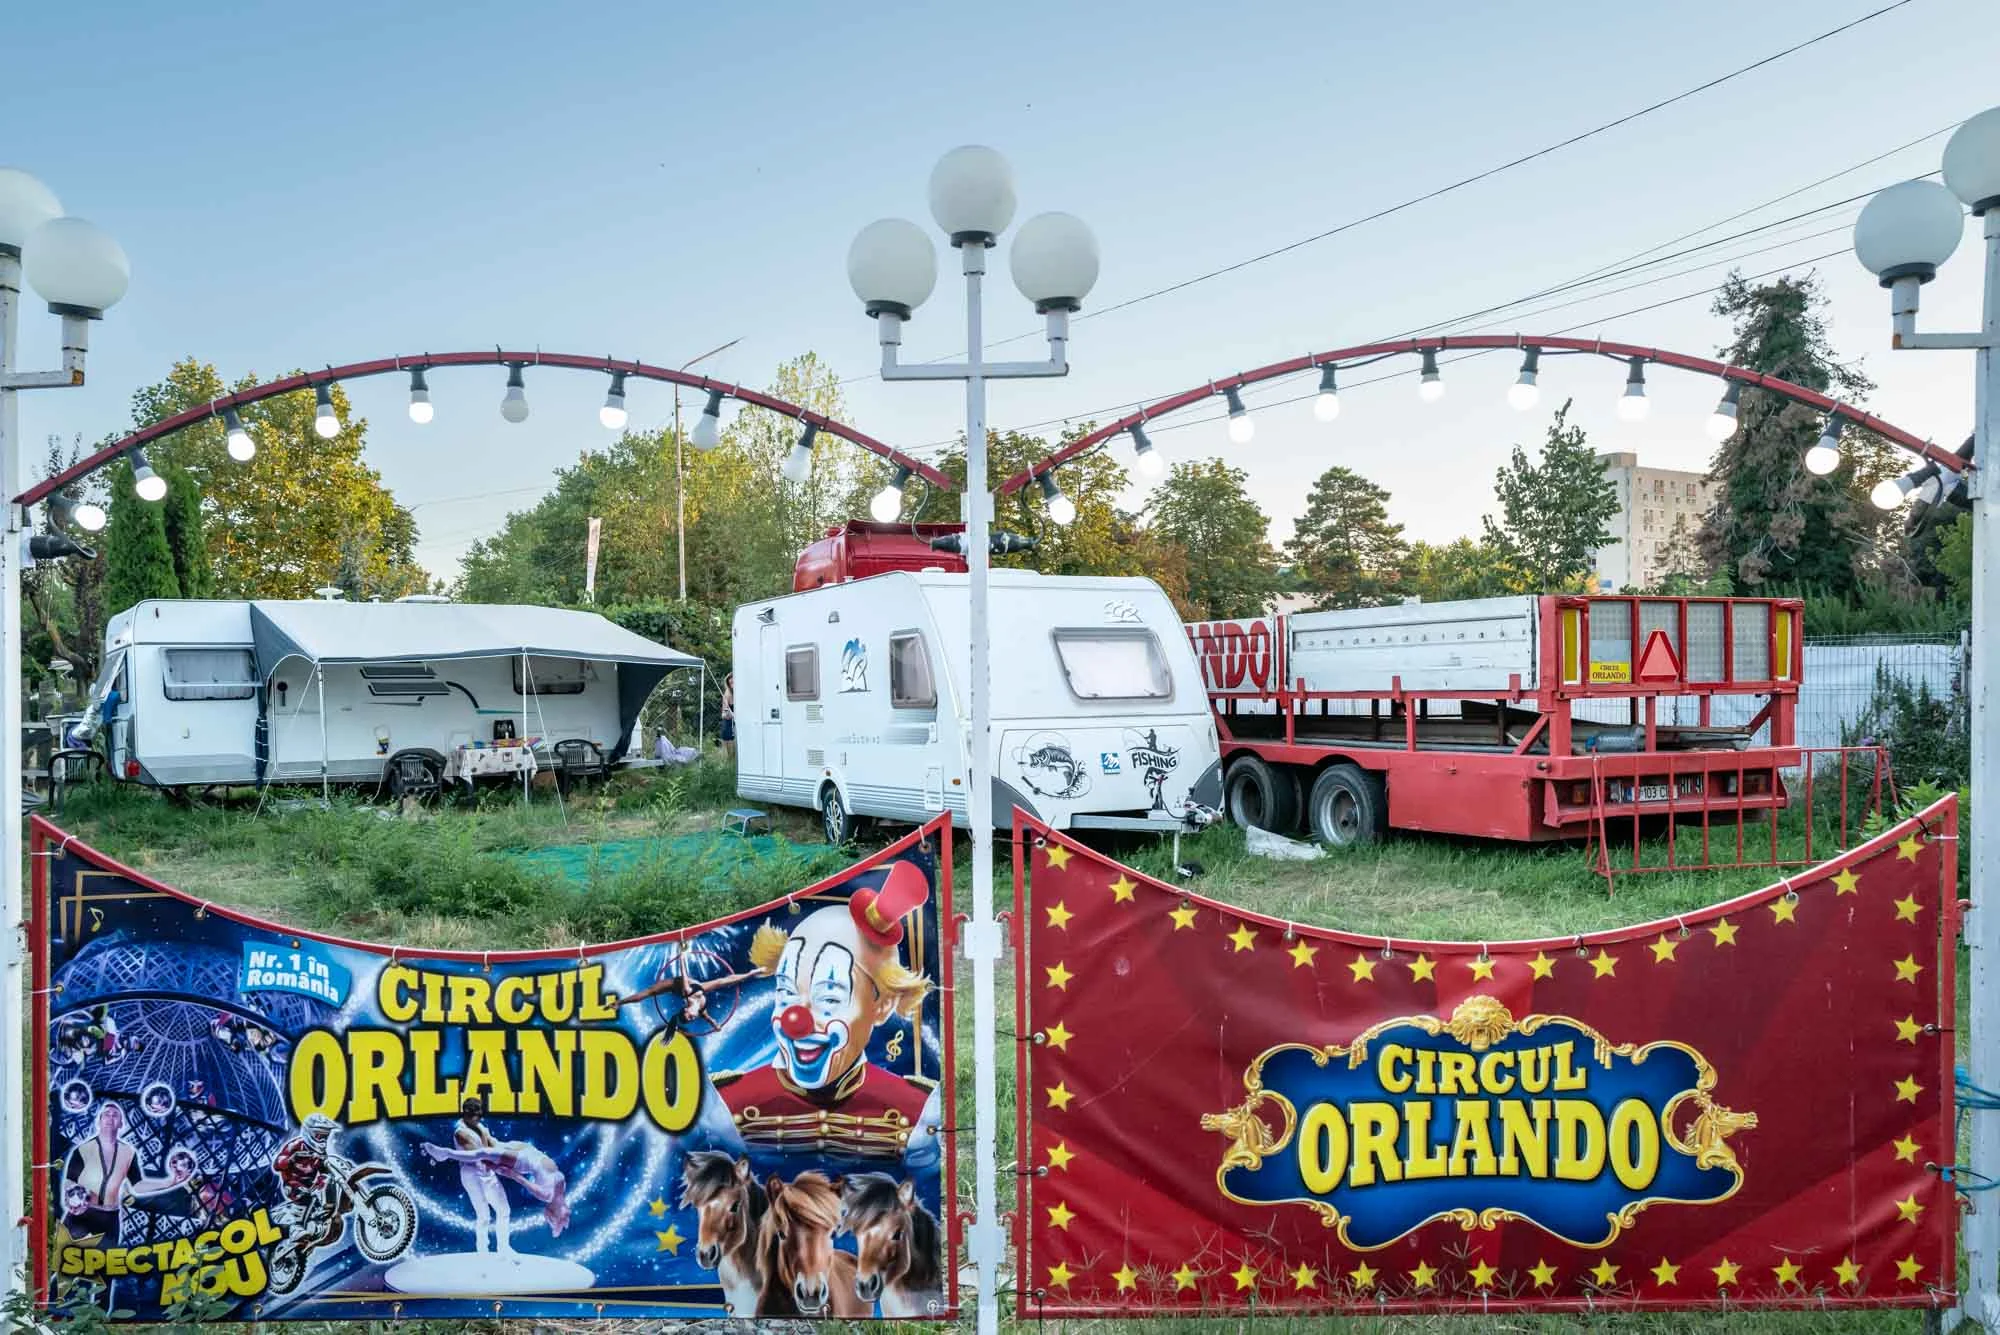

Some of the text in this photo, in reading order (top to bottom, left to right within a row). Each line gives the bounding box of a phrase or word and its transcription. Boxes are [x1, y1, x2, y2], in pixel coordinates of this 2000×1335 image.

[1592, 671, 1627, 680] ORLANDO
[1131, 751, 1177, 769] FISHING
[246, 968, 339, 1003] România
[248, 951, 329, 978] Nr. 1 în
[378, 964, 617, 1024] CIRCUL
[290, 1029, 701, 1132] ORLANDO
[1378, 1040, 1587, 1094] CIRCUL
[1298, 1098, 1660, 1194] ORLANDO
[62, 1208, 283, 1276] SPECTACOL
